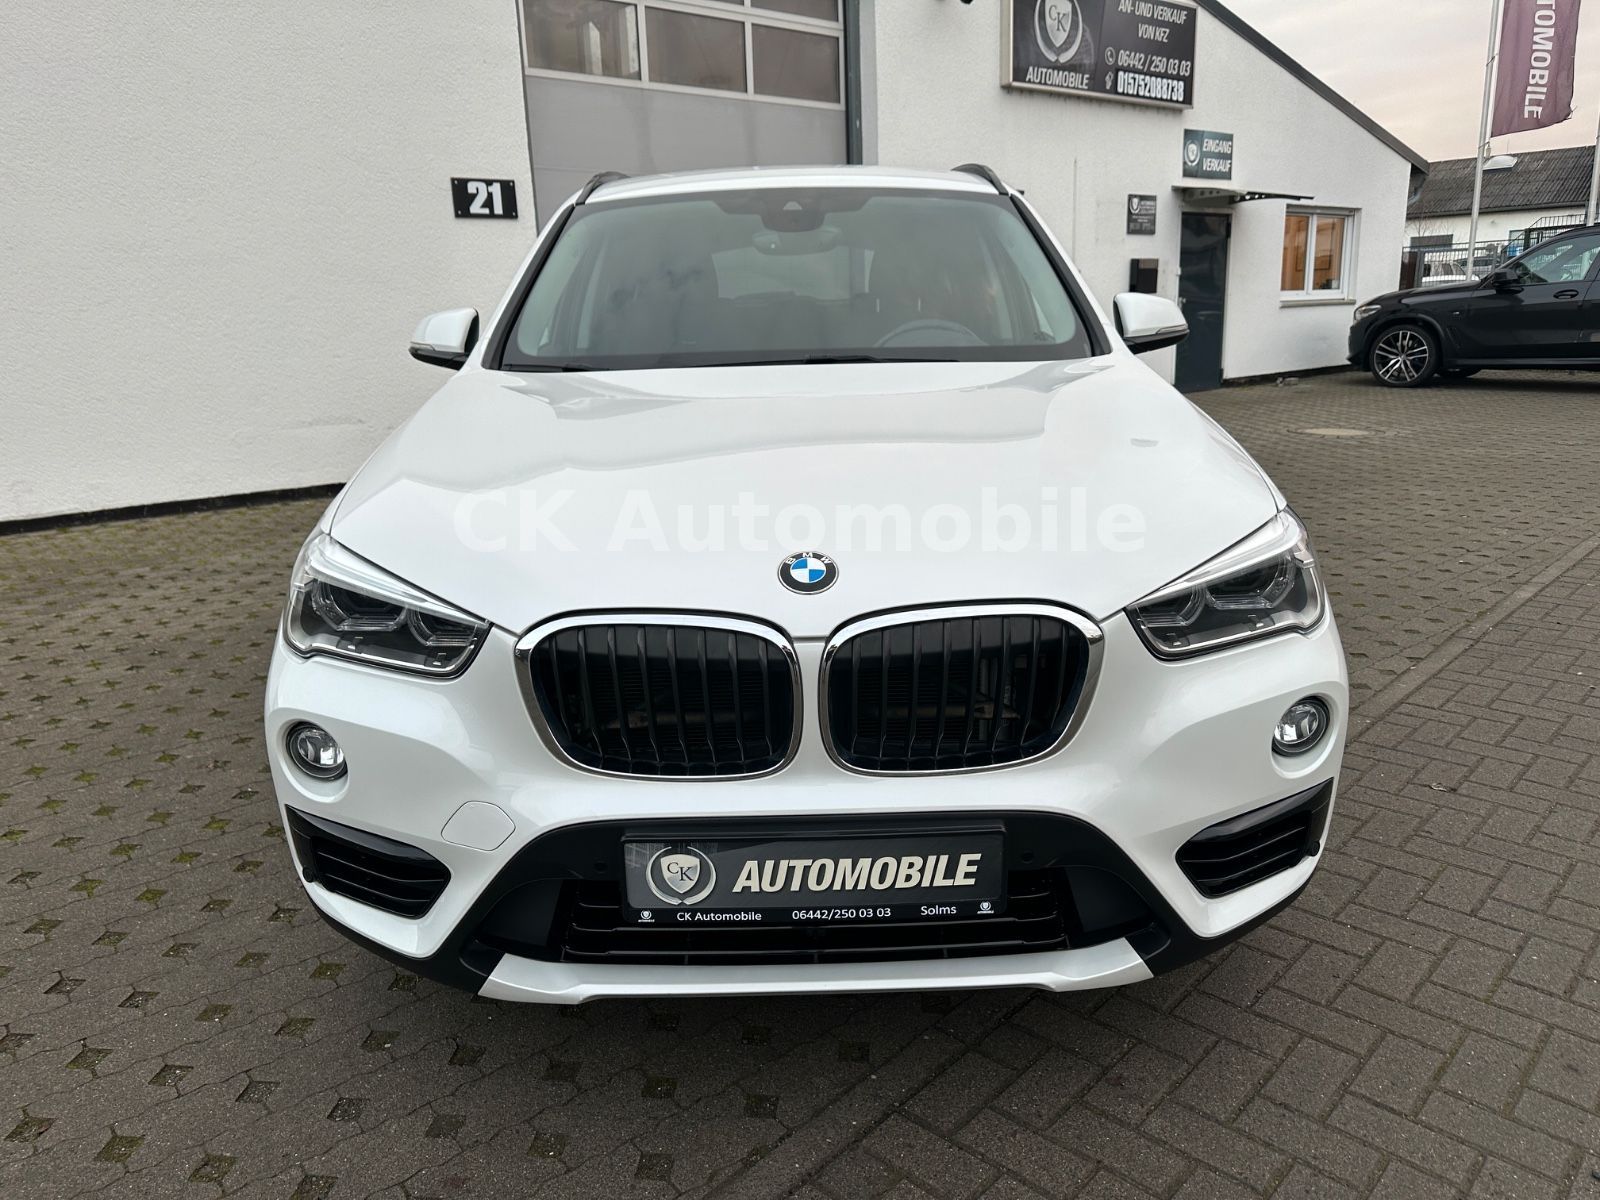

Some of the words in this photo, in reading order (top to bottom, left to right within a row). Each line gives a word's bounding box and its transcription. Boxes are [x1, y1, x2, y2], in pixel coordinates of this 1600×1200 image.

[1134, 2, 1153, 18] UND
[1153, 5, 1187, 24] VERKAUF
[1138, 23, 1155, 39] VON
[1155, 26, 1169, 42] KFZ
[1117, 50, 1144, 69] 06442
[1150, 55, 1167, 74] 250
[1167, 59, 1179, 76] 03
[1179, 60, 1191, 77] 03
[1026, 66, 1089, 89] AUTOMOBILE
[1203, 139, 1231, 153] EINGANG
[1203, 158, 1231, 171] VERKAUF
[467, 181, 503, 215] 21
[785, 551, 833, 564] BMW
[732, 853, 982, 893] AUTOMOBILE
[676, 911, 692, 921] CK
[694, 911, 762, 922] Automobile
[792, 908, 856, 921] 06442/250
[859, 907, 873, 919] 03
[876, 906, 891, 918] 03
[920, 904, 957, 916] Solms
